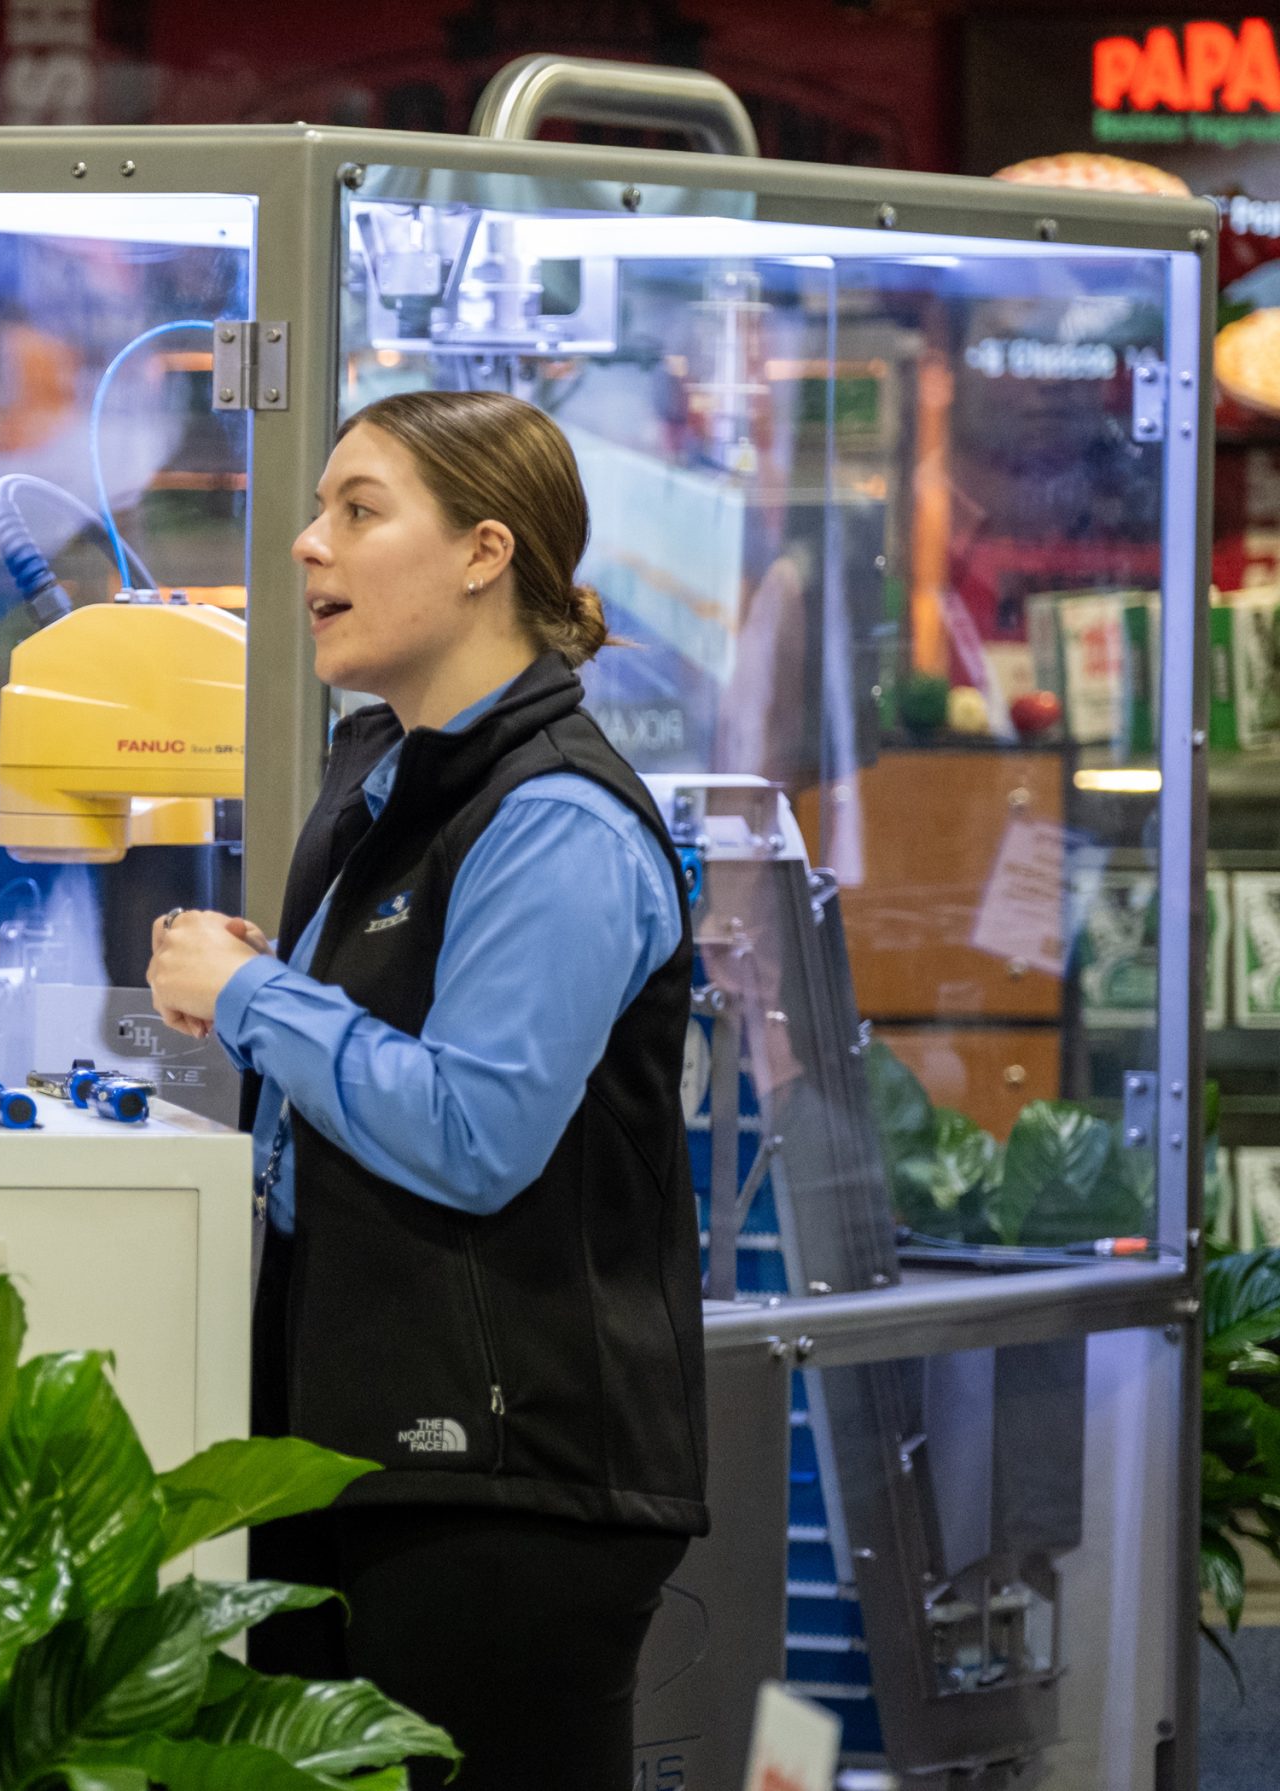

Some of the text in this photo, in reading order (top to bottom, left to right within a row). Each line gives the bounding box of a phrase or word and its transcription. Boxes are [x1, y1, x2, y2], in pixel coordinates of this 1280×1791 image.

[1091, 16, 1280, 113] PAPA
[117, 740, 185, 753] FANUC
[416, 1418, 443, 1430] THE
[398, 1430, 443, 1442] NORTH
[410, 1441, 443, 1452] FACE
